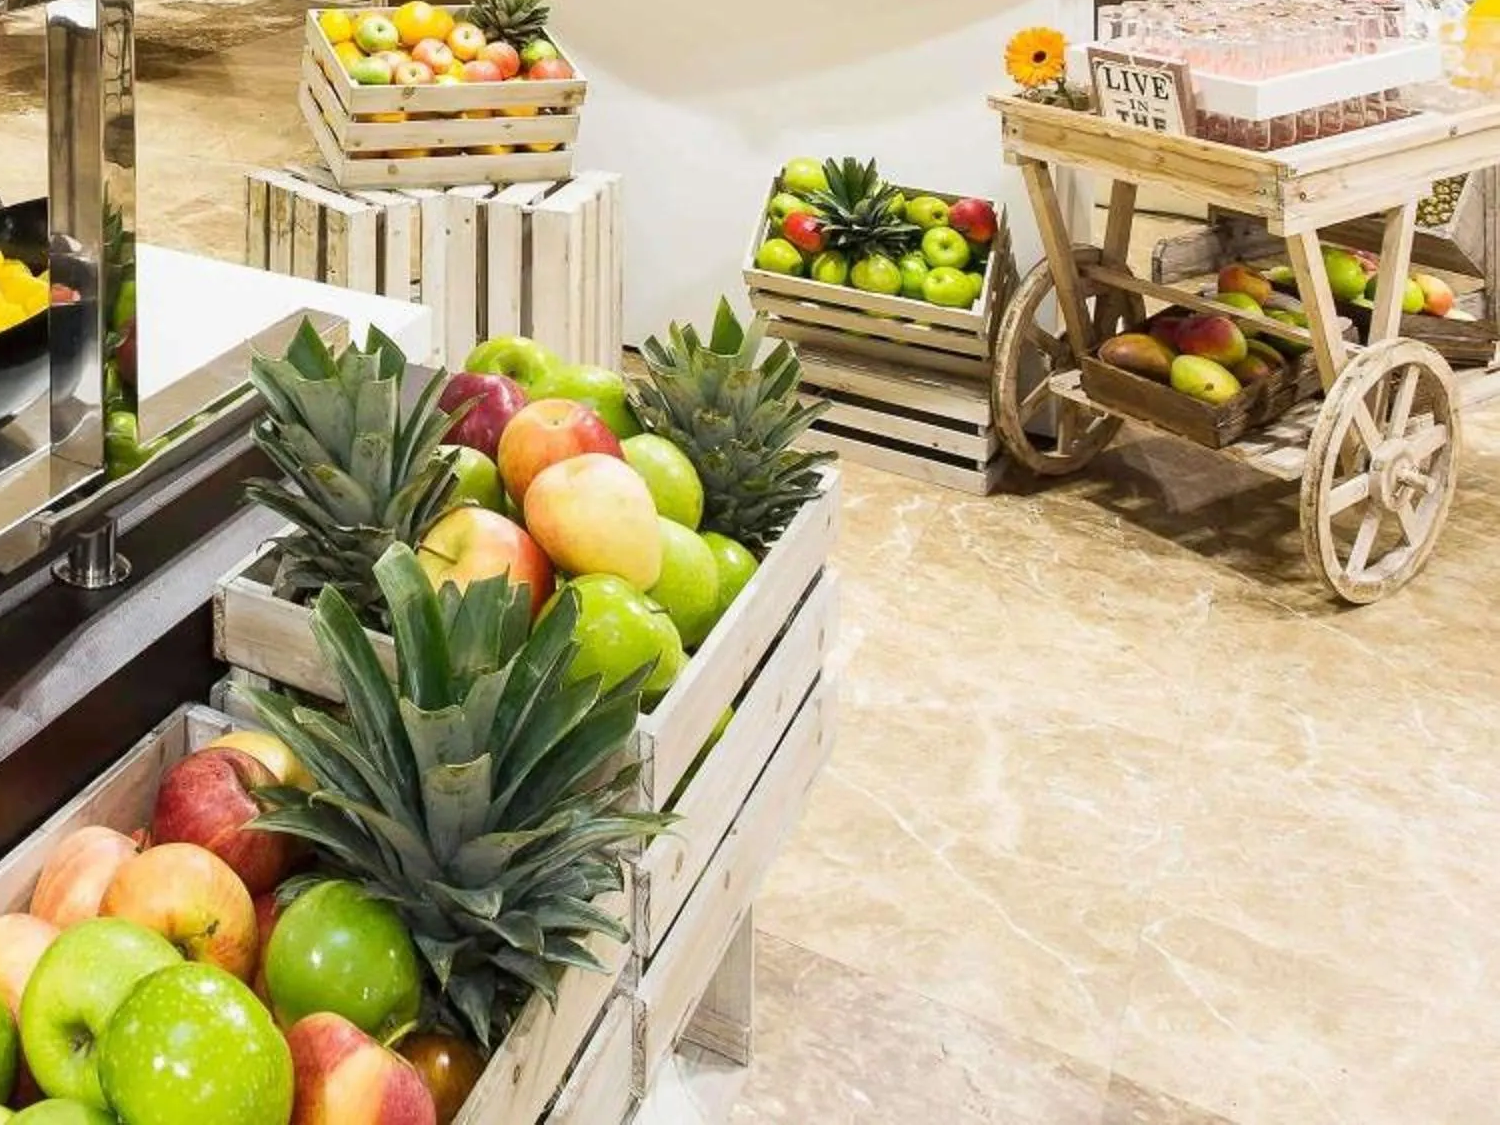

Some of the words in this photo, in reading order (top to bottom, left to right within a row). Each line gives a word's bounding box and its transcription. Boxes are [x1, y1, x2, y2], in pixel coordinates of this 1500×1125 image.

[1103, 66, 1169, 100] LIVE
[1129, 98, 1149, 113] IN
[1116, 109, 1167, 131] THE
